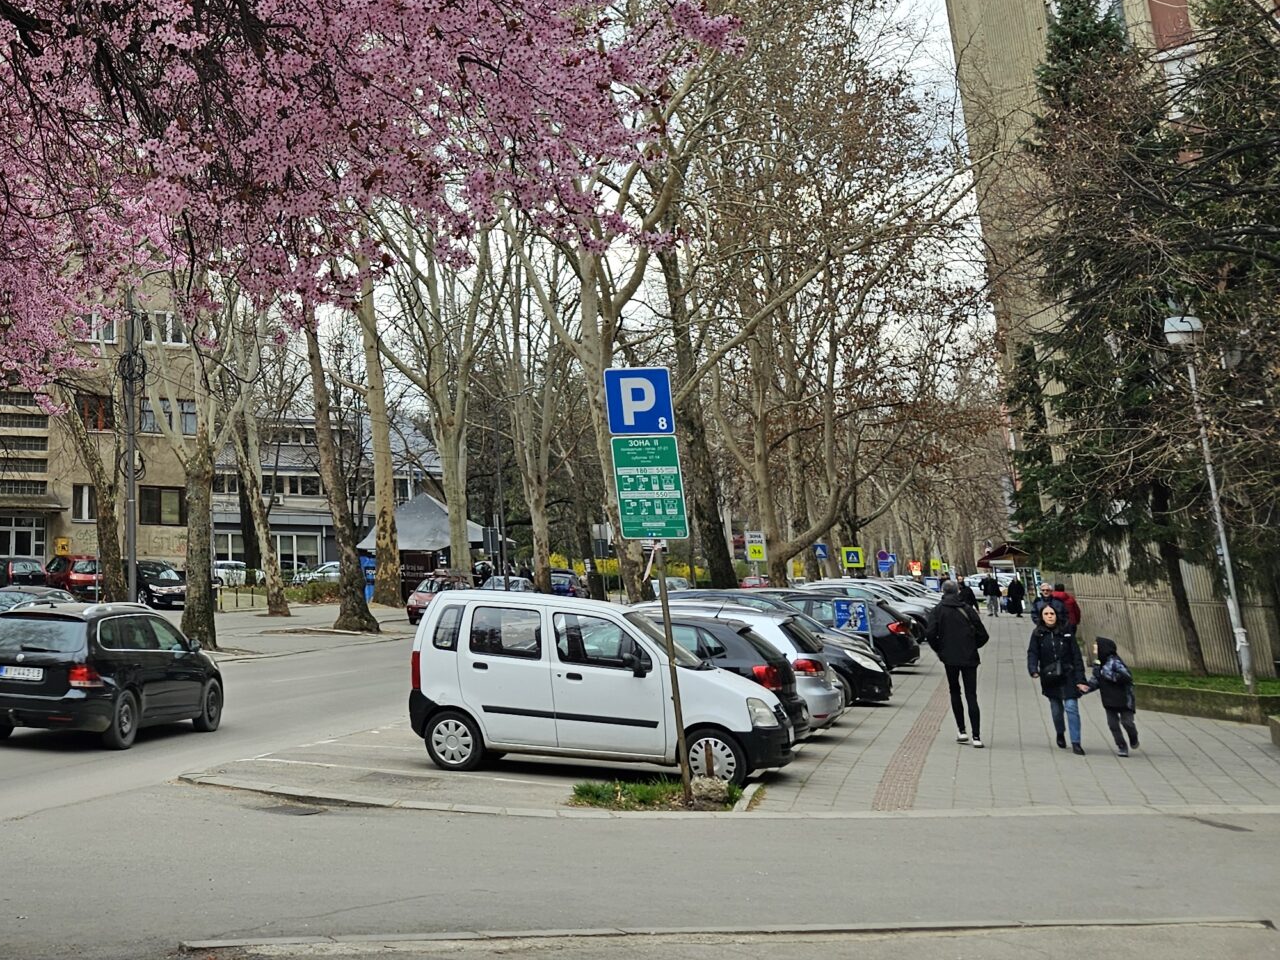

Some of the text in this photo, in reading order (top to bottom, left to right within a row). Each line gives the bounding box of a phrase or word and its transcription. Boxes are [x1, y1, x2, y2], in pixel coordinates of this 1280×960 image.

[619, 377, 656, 426] P
[658, 416, 668, 430] 8
[628, 439, 651, 447] ЗОНА
